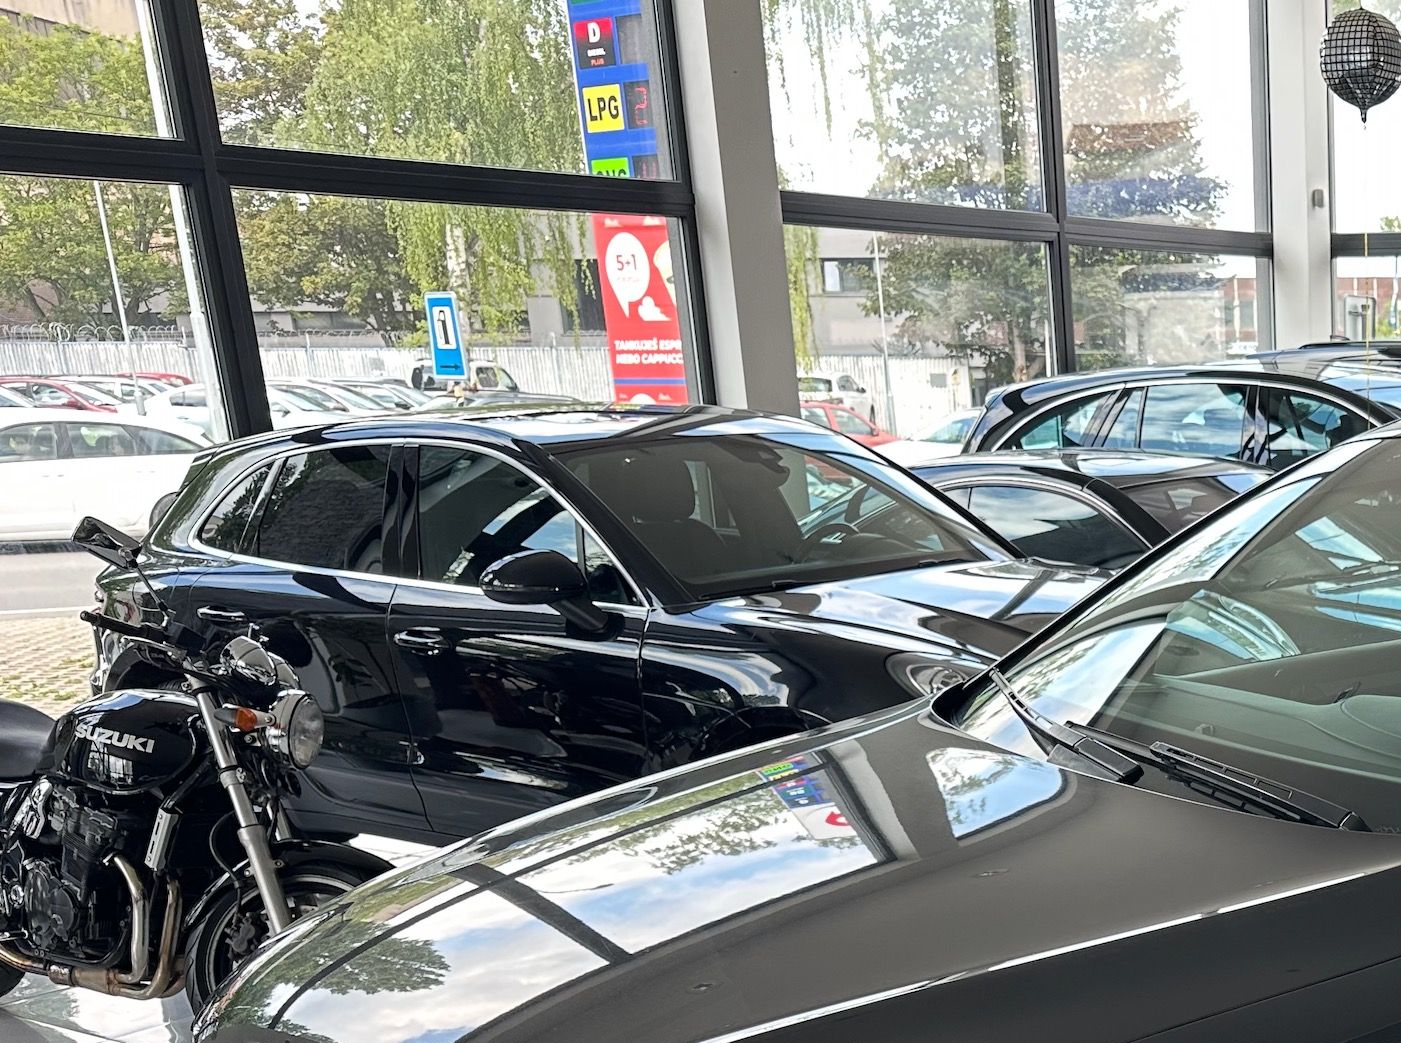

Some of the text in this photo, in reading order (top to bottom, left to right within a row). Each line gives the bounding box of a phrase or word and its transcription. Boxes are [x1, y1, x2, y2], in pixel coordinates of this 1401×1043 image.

[587, 22, 600, 43] D
[587, 96, 620, 121] LPG
[616, 254, 637, 271] 5+1
[75, 723, 155, 753] SUZUKI
